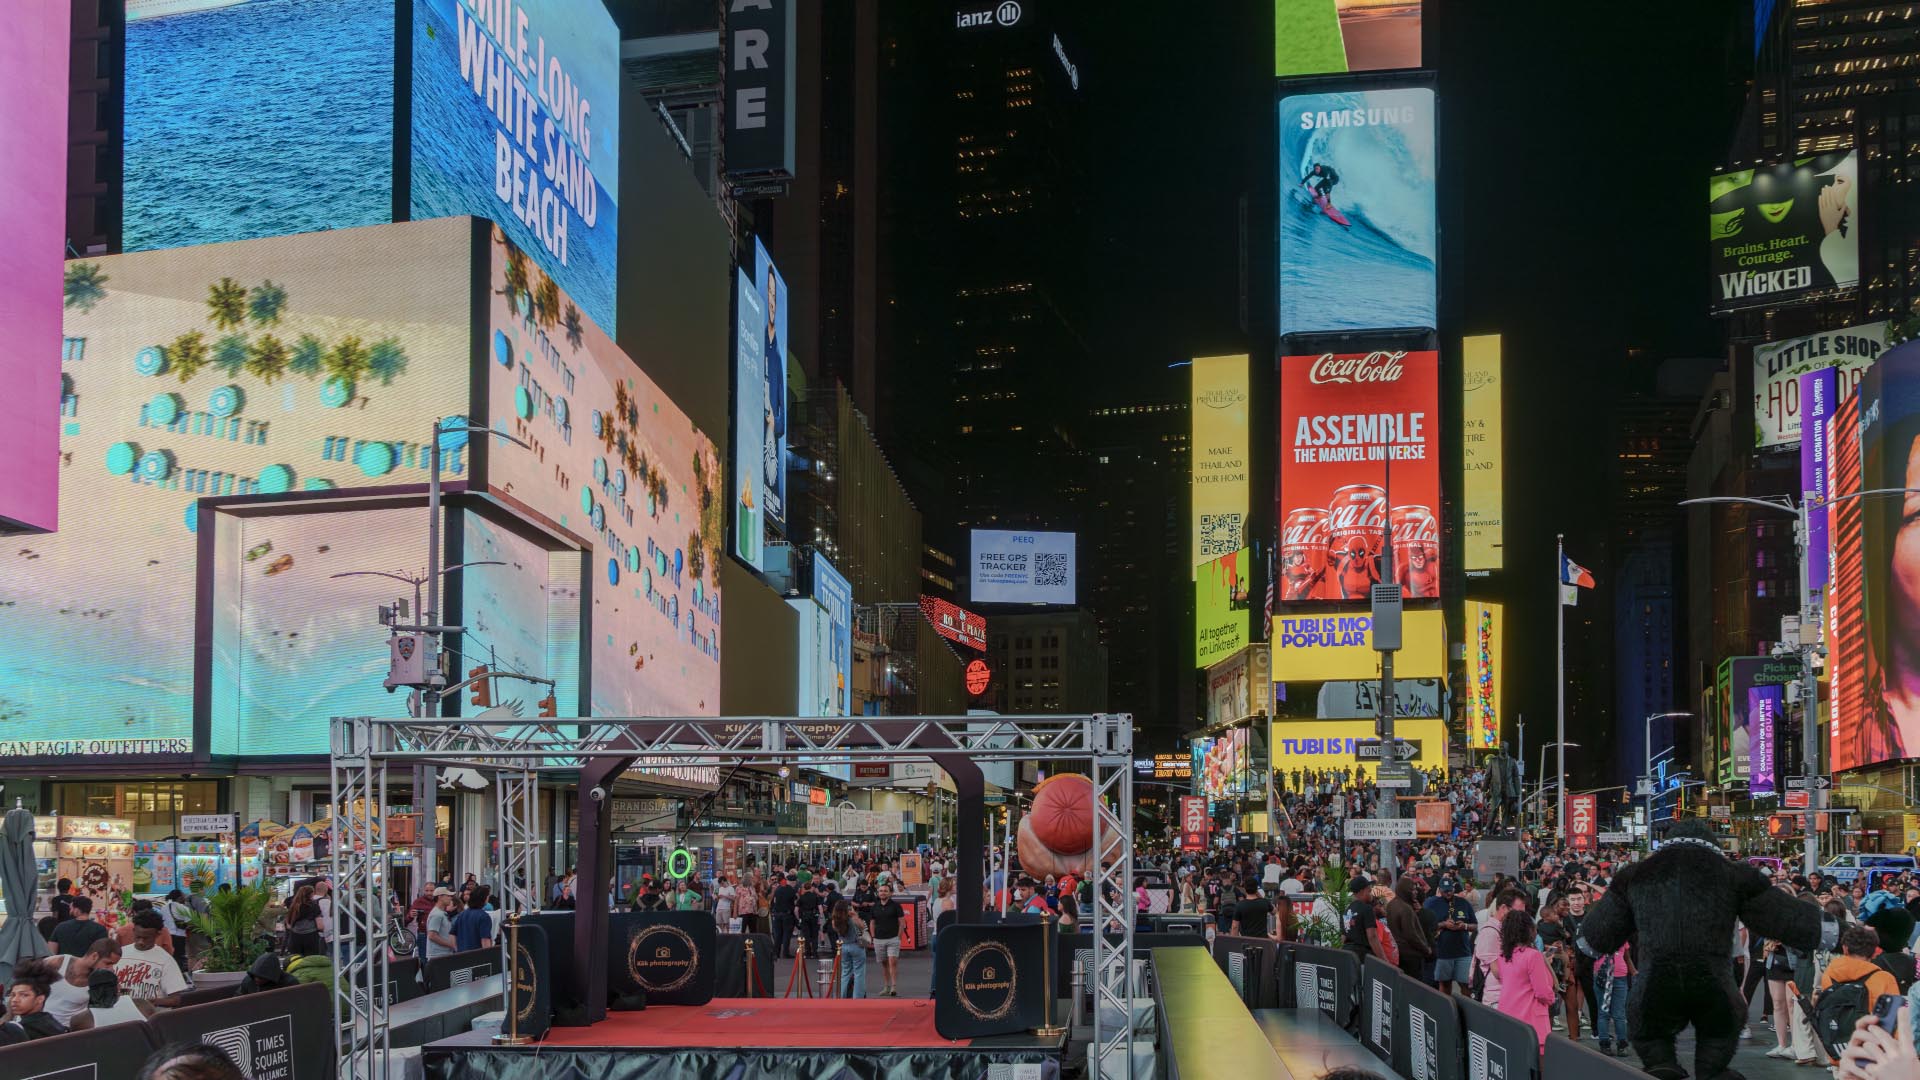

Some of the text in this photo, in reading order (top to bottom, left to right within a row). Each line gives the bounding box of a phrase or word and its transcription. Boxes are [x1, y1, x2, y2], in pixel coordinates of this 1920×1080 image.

[457, 2, 597, 228] WHITE SAND
[1301, 106, 1415, 130] SAMSUNG
[496, 128, 568, 266] BEACH
[1724, 235, 1809, 258] Brains. Heart.
[1738, 250, 1794, 266] Courage.
[1768, 336, 1881, 378] LITTLE SHOP
[1309, 351, 1408, 384] Coca-Cola
[1295, 412, 1424, 446] ASSEMBLE
[1209, 448, 1232, 456] MAKE
[1294, 445, 1425, 463] THE MARVEL UNVERSE
[1200, 460, 1242, 469] THAILAND
[1013, 536, 1034, 544] PEEQ
[980, 562, 1026, 571] TRACKER
[822, 586, 845, 628] TEQUILA
[967, 624, 985, 639] PLAZA
[1200, 622, 1238, 642] All together
[1282, 619, 1320, 633] TUBI
[1323, 618, 1336, 632] IS
[1282, 632, 1365, 648] POPULAR
[1200, 646, 1208, 657] on
[1764, 664, 1787, 672] Pick
[36, 741, 84, 755] EAGLE
[90, 739, 187, 755] OUTFITTERS
[1282, 739, 1324, 754] TUBI
[1327, 738, 1342, 753] IS
[613, 801, 675, 811] GRAND SLAM
[1188, 798, 1204, 832] tkts
[1573, 797, 1592, 834] tkts
[977, 981, 1009, 991] photography
[1320, 978, 1333, 988] TIMES
[256, 1034, 284, 1053] TIMES
[255, 1050, 288, 1070] SQUARE
[258, 1067, 288, 1080] ALLIANCE
